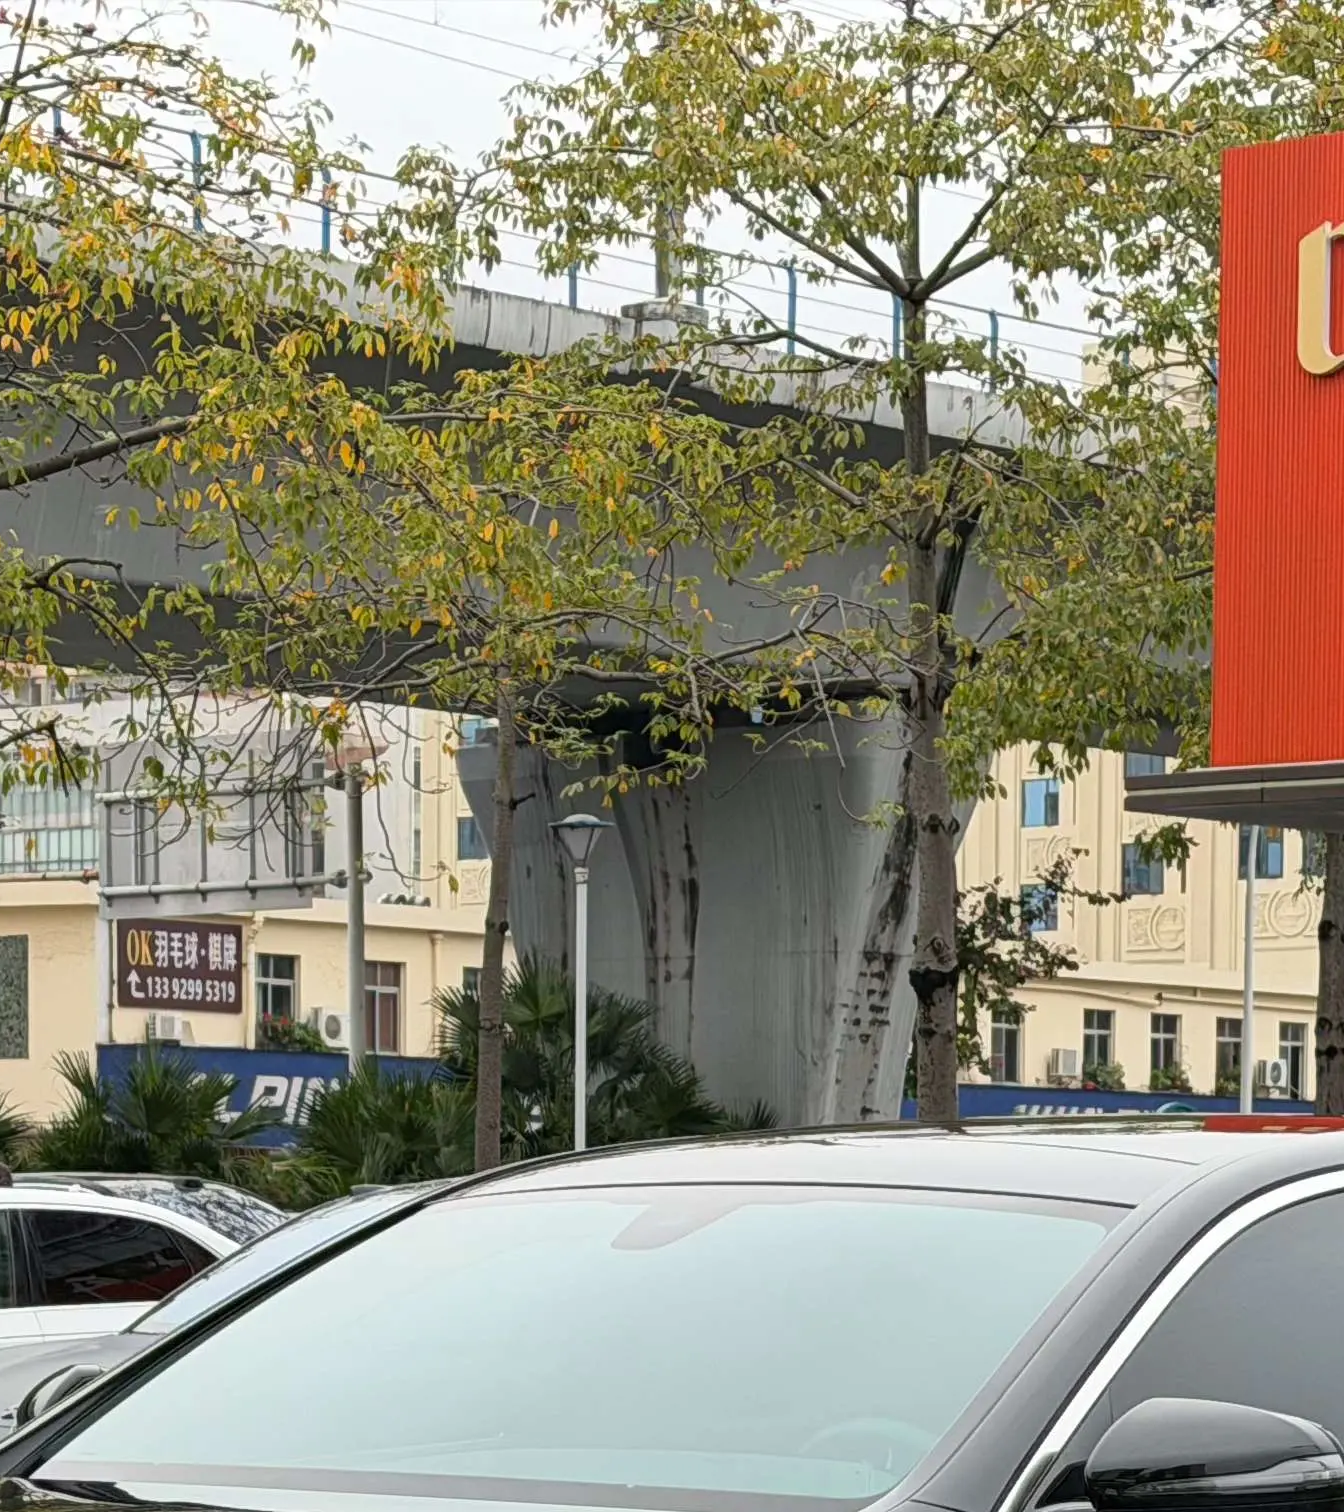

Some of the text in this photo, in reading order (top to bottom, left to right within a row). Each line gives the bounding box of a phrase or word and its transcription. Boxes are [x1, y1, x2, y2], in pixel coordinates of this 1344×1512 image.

[146, 976, 236, 1003] 133 9299 5319
